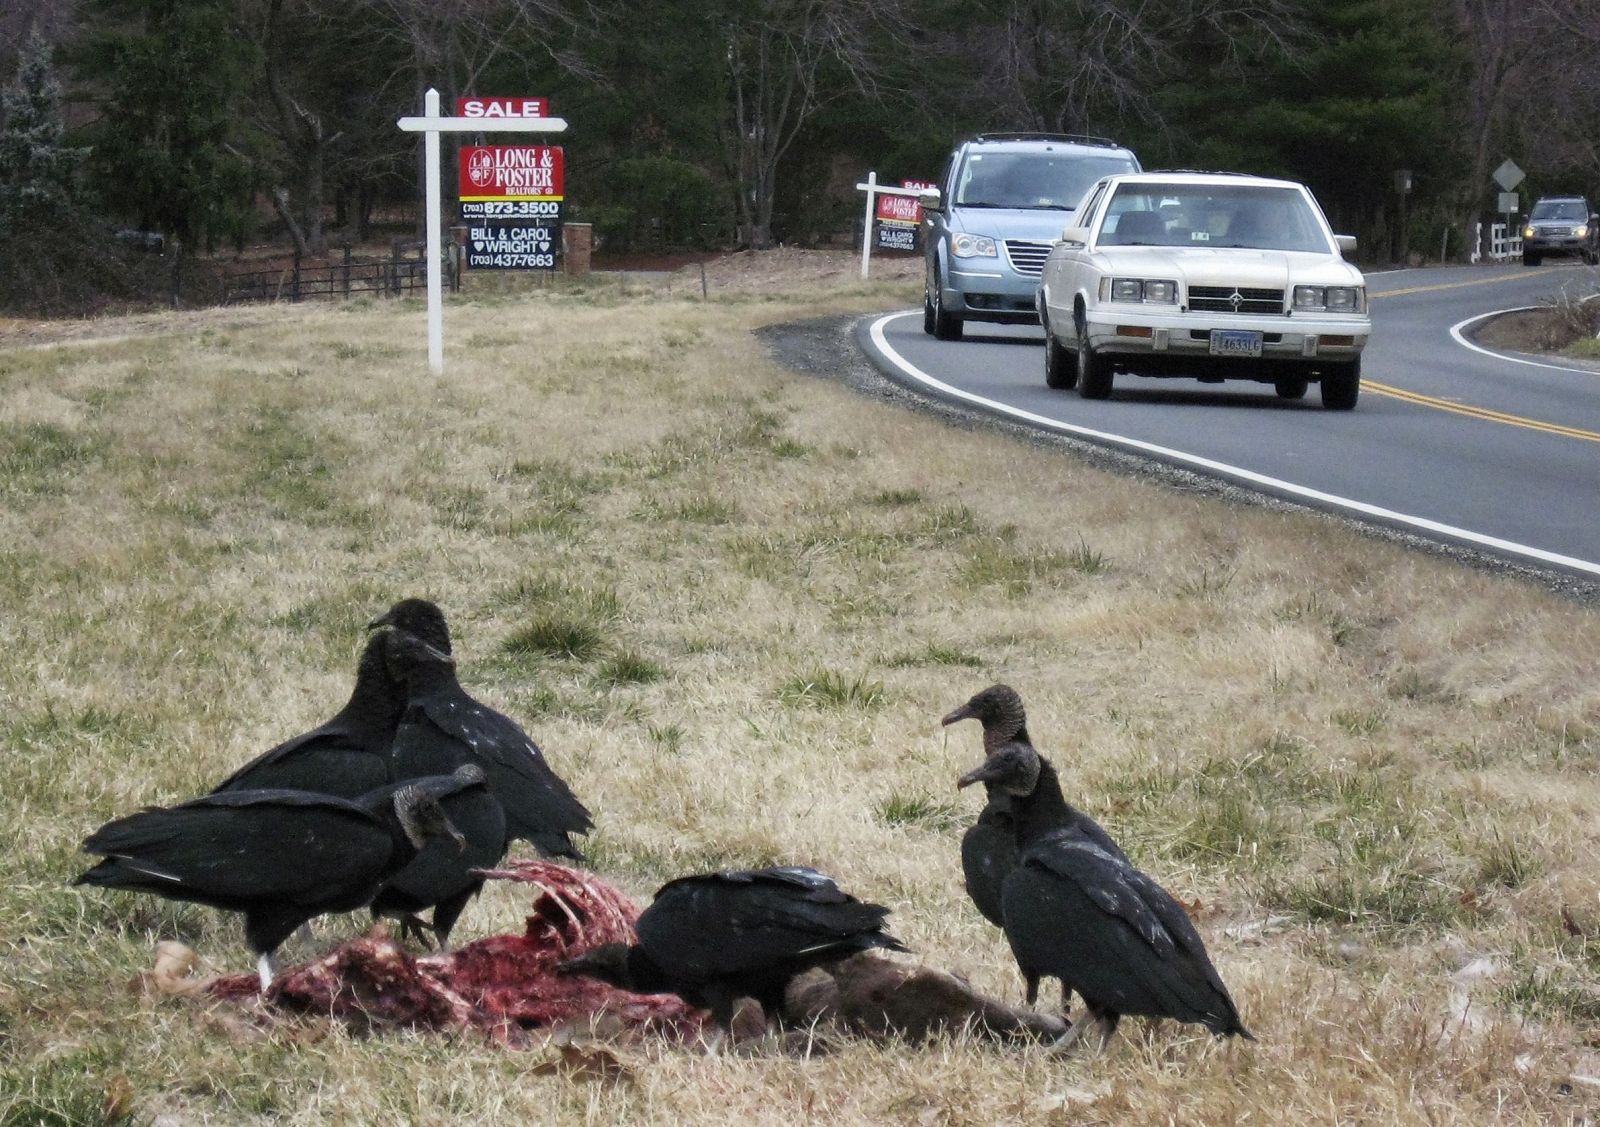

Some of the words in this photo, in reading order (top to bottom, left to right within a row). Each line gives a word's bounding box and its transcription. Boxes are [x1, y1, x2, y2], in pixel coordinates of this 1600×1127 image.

[464, 101, 540, 117] SALE
[495, 149, 536, 168] LONG
[541, 149, 553, 168] &
[495, 168, 553, 187] FOSTER
[904, 181, 937, 190] SALE
[471, 228, 495, 240] BILL
[498, 228, 508, 240] &
[511, 228, 552, 241] CAROL
[486, 241, 539, 253] WRIGHT
